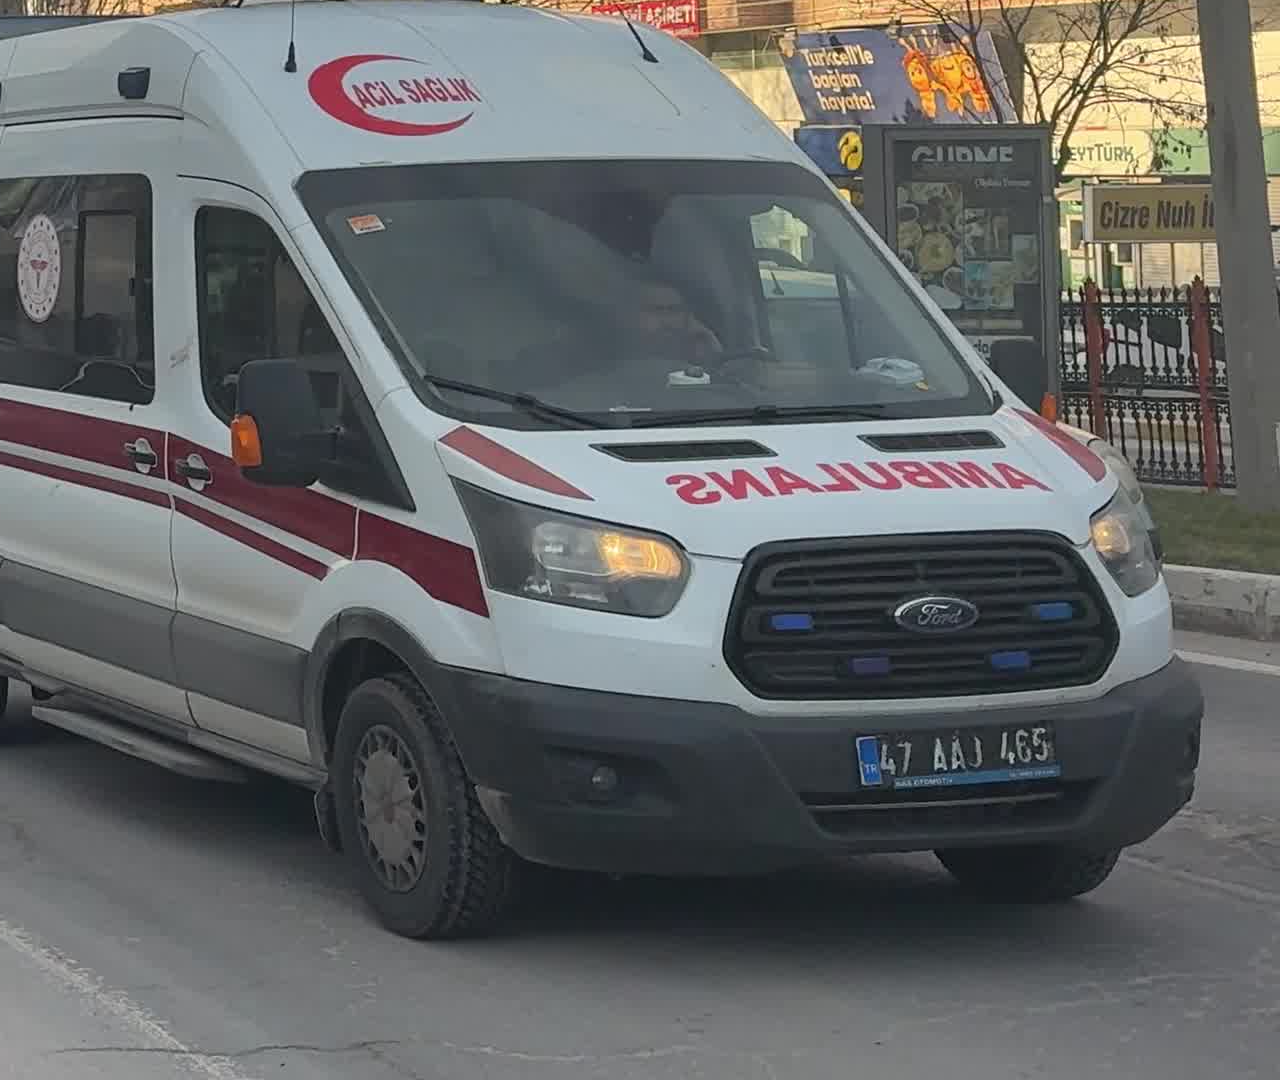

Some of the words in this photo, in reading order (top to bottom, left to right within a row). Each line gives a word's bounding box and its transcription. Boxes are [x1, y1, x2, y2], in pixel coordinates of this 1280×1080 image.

[808, 69, 862, 93] bağlan
[816, 91, 875, 115] hayata!
[1099, 200, 1151, 231] Cizre
[1156, 200, 1196, 232] Nuh
[917, 602, 963, 626] Ford
[864, 763, 878, 774] TR
[880, 741, 913, 776] 47
[933, 735, 984, 772] AAJ
